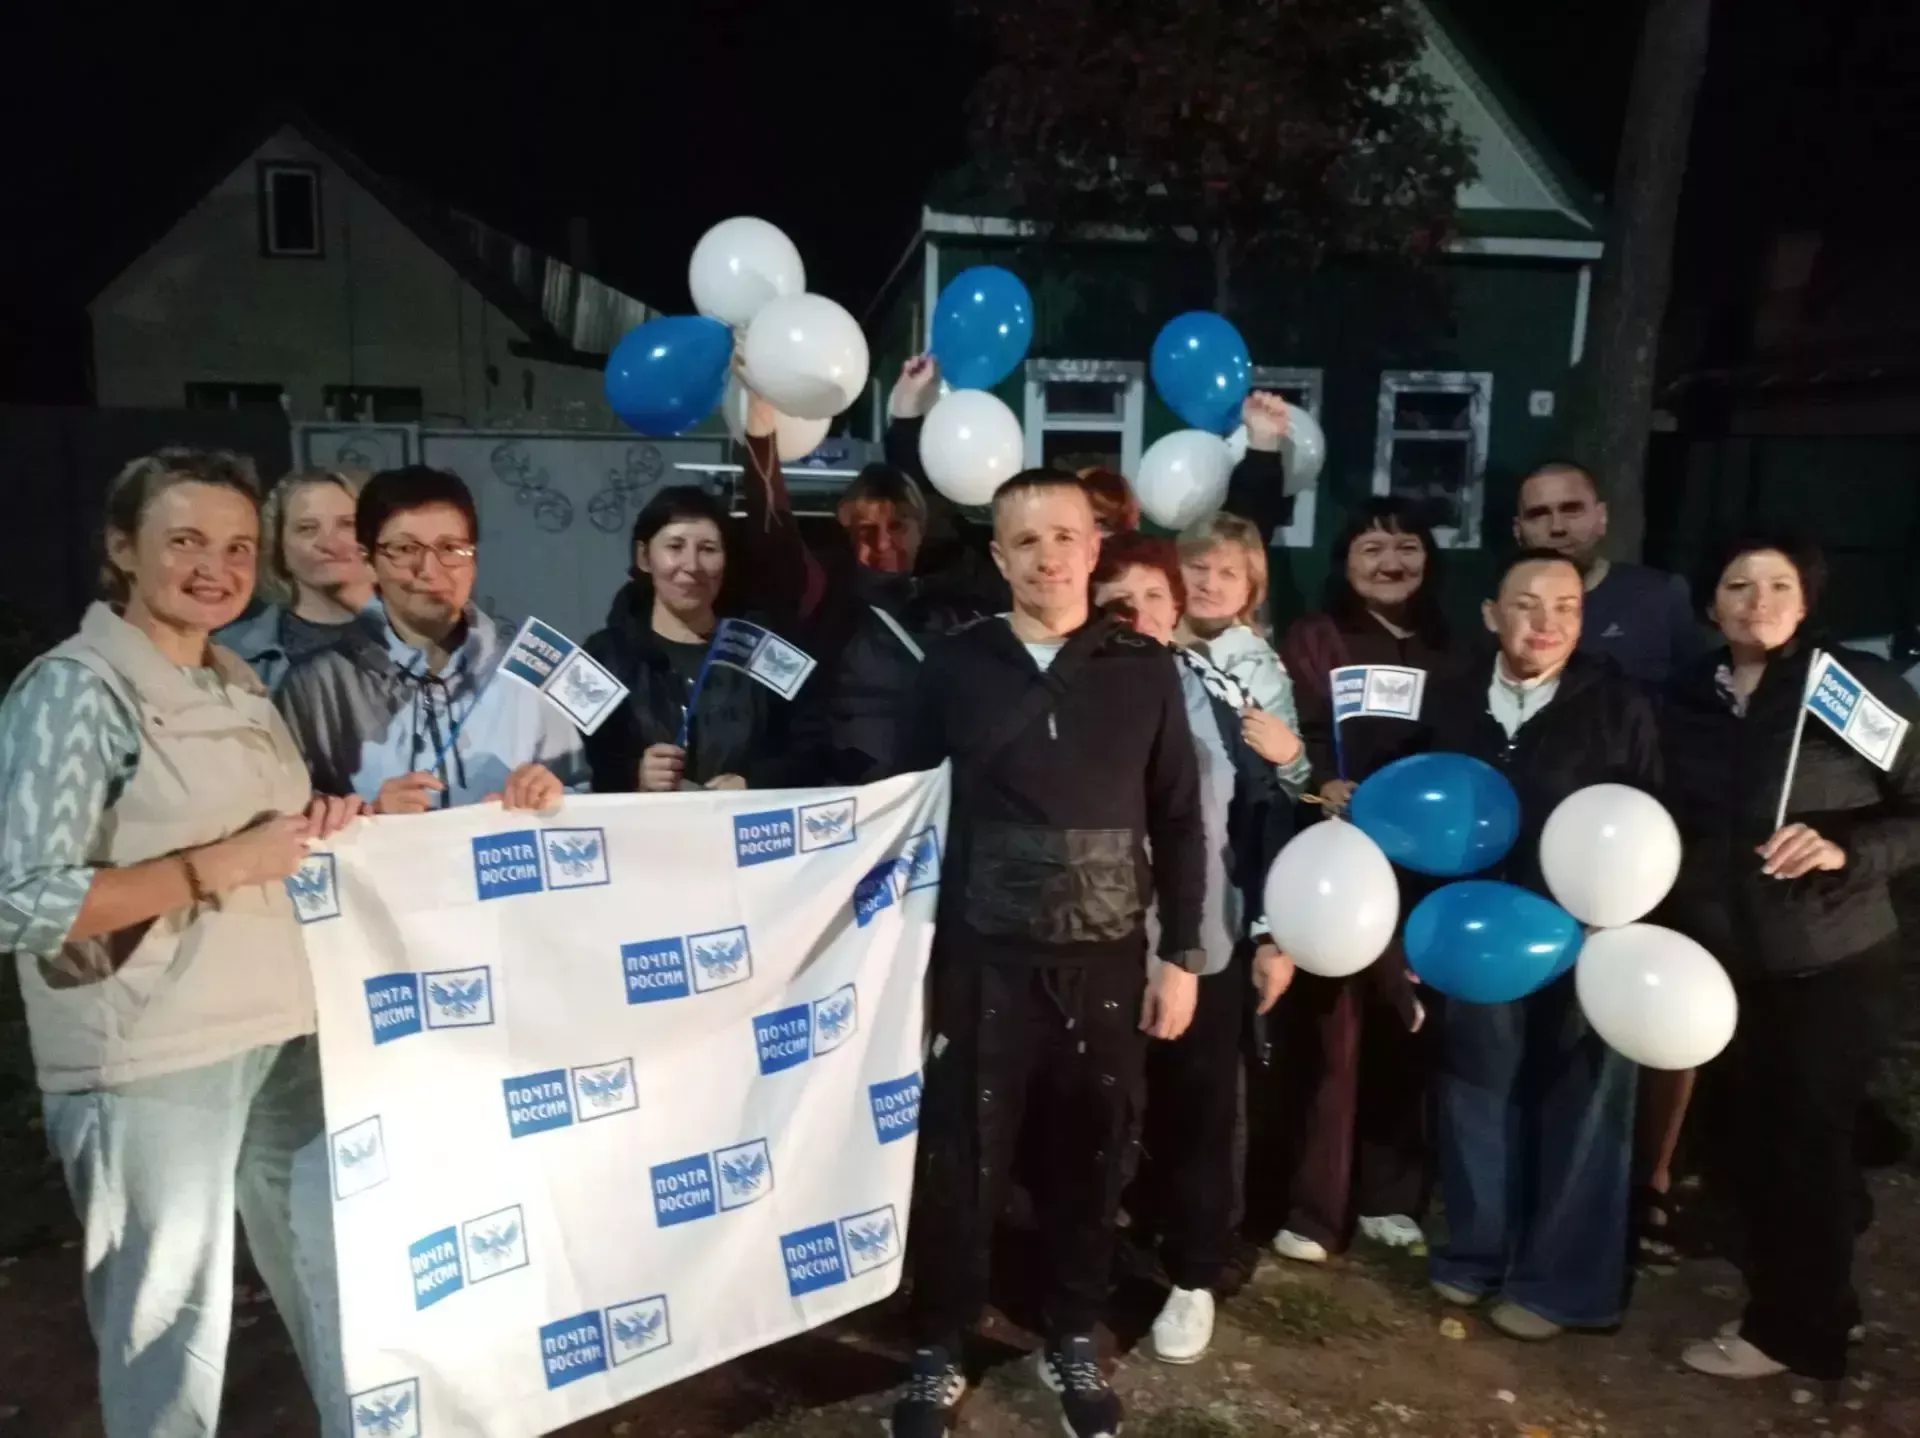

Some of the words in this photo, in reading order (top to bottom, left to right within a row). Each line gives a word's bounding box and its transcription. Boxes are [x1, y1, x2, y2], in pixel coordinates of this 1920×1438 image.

[739, 821, 792, 840] ПОЧТА
[478, 844, 535, 865] ПОЧТА
[740, 836, 793, 856] РОССИИ
[481, 865, 538, 885] РОССИИ
[627, 950, 682, 972] ПОЧТА
[629, 969, 685, 991] РОССИИ
[369, 986, 413, 1009] ПОЧТА
[758, 1018, 808, 1043] ПОЧТА
[761, 1037, 808, 1060] РОССИИ
[508, 1081, 564, 1106] ПОЧТА
[874, 1085, 921, 1112] ПОЧТА
[511, 1099, 568, 1125] РОССИИ
[655, 1168, 708, 1193] ПОЧТА
[658, 1188, 711, 1213] РОССИИ
[411, 1240, 455, 1267] ПОЧТА
[787, 1236, 835, 1262] ПОЧТА
[790, 1257, 840, 1282] РОССИИ
[545, 1325, 599, 1354] ПОЧТА
[548, 1345, 602, 1374] РОССИИ
